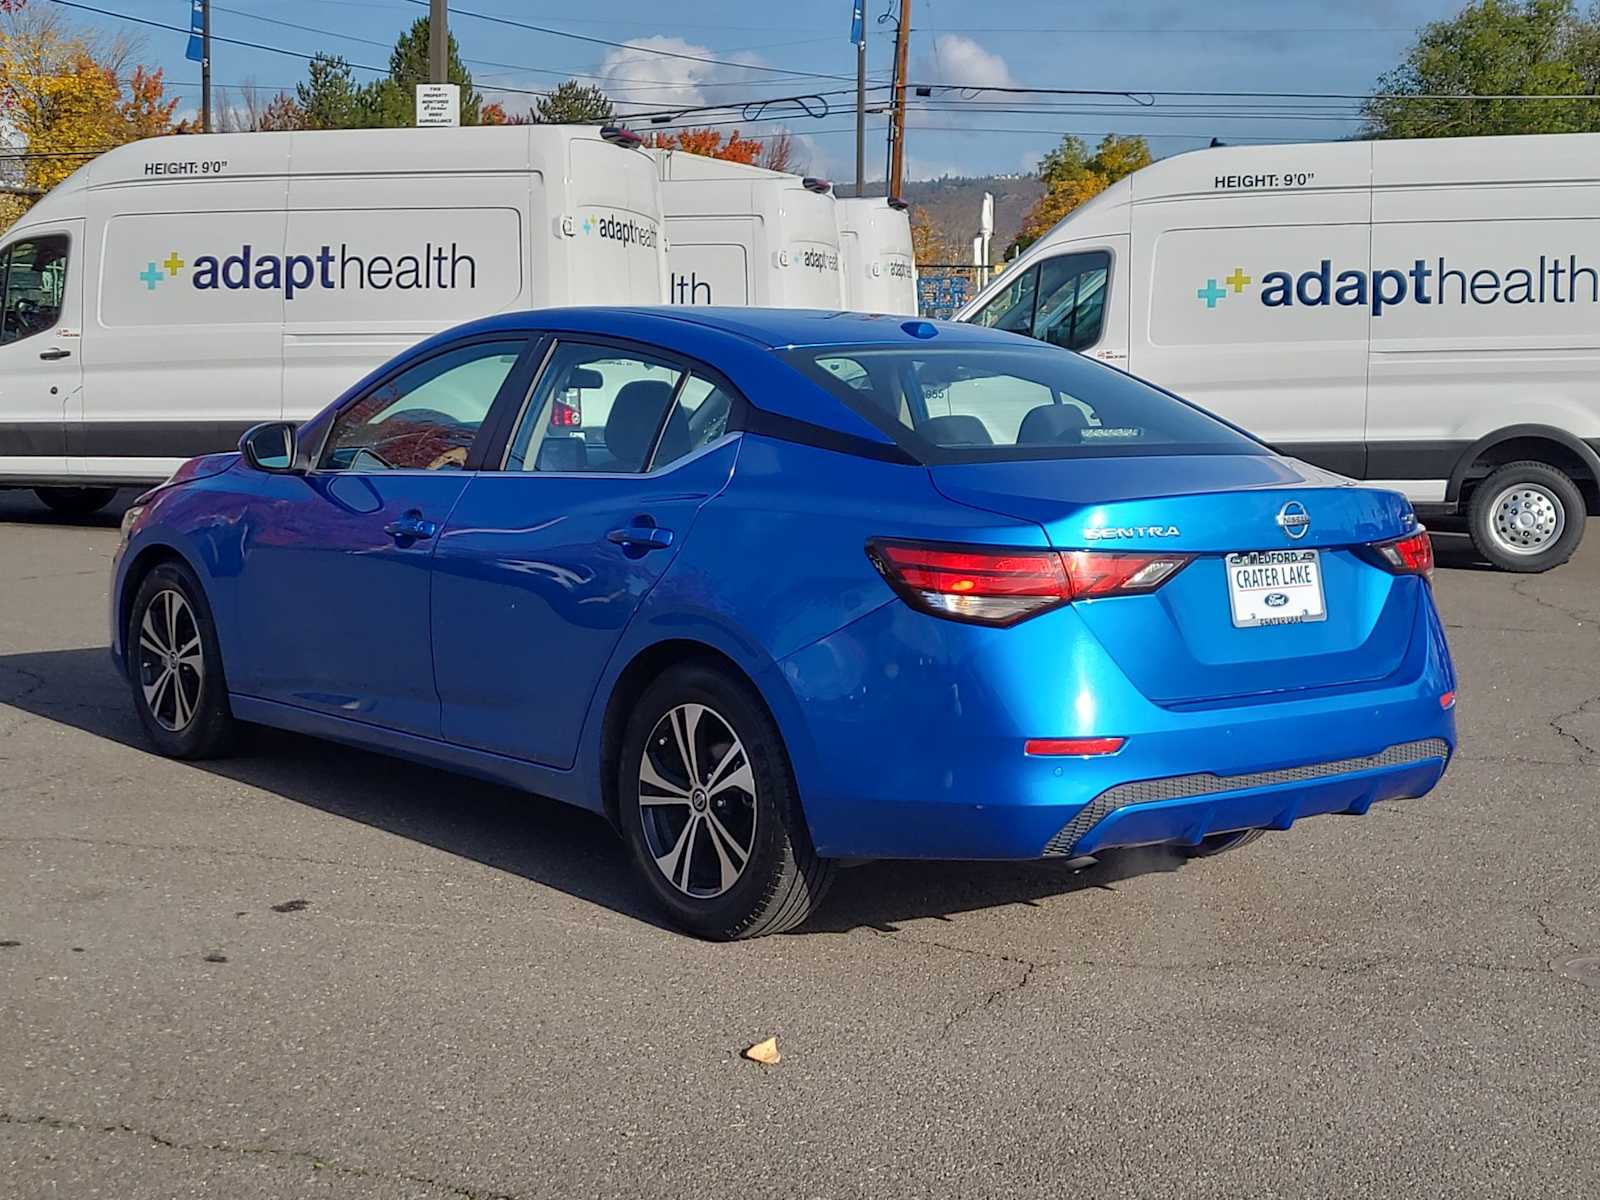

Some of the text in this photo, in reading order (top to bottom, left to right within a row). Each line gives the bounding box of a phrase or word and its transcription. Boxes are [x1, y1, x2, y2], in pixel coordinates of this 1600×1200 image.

[144, 162, 198, 175] HEIGHT:
[1215, 174, 1280, 188] HEIGHT:
[192, 243, 476, 299] adapthealth
[1261, 254, 1599, 316] adapthealth
[1083, 526, 1181, 541] SENTRA
[1249, 552, 1299, 565] MEDFORD
[1236, 565, 1312, 588] CRATER LAKE
